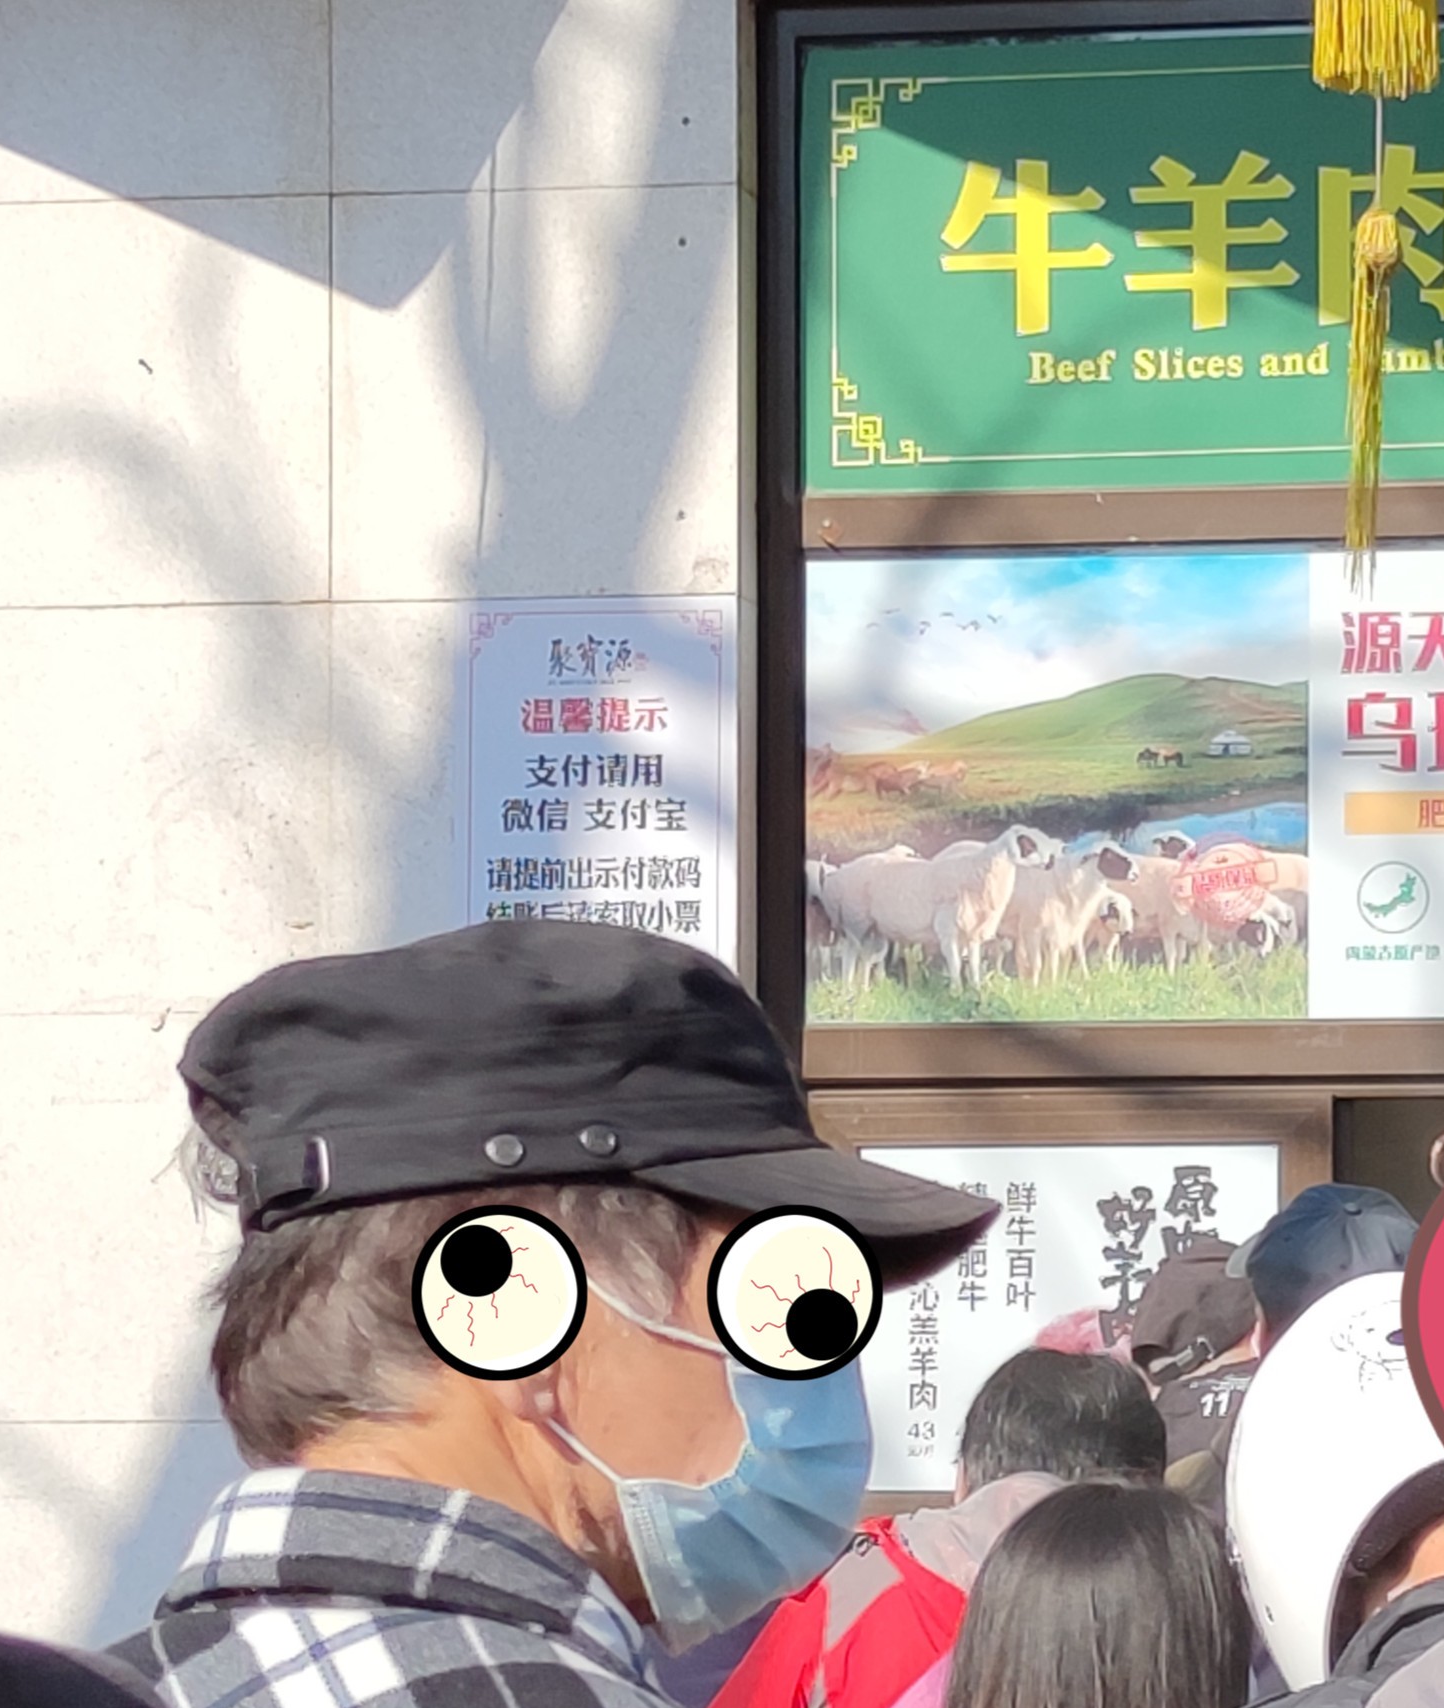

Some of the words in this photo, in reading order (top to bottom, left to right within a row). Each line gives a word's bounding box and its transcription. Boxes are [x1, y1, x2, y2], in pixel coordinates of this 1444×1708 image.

[1027, 350, 1116, 387] Beef
[1131, 346, 1244, 382] Slices
[1258, 341, 1329, 378] and
[520, 697, 669, 734] 温馨提示
[524, 753, 664, 788] 支付请用
[501, 797, 570, 832] 微信
[582, 797, 688, 832] 支付宝
[486, 856, 702, 892] 请提前出示付款码
[1005, 1181, 1038, 1312] 鲜牛百叶
